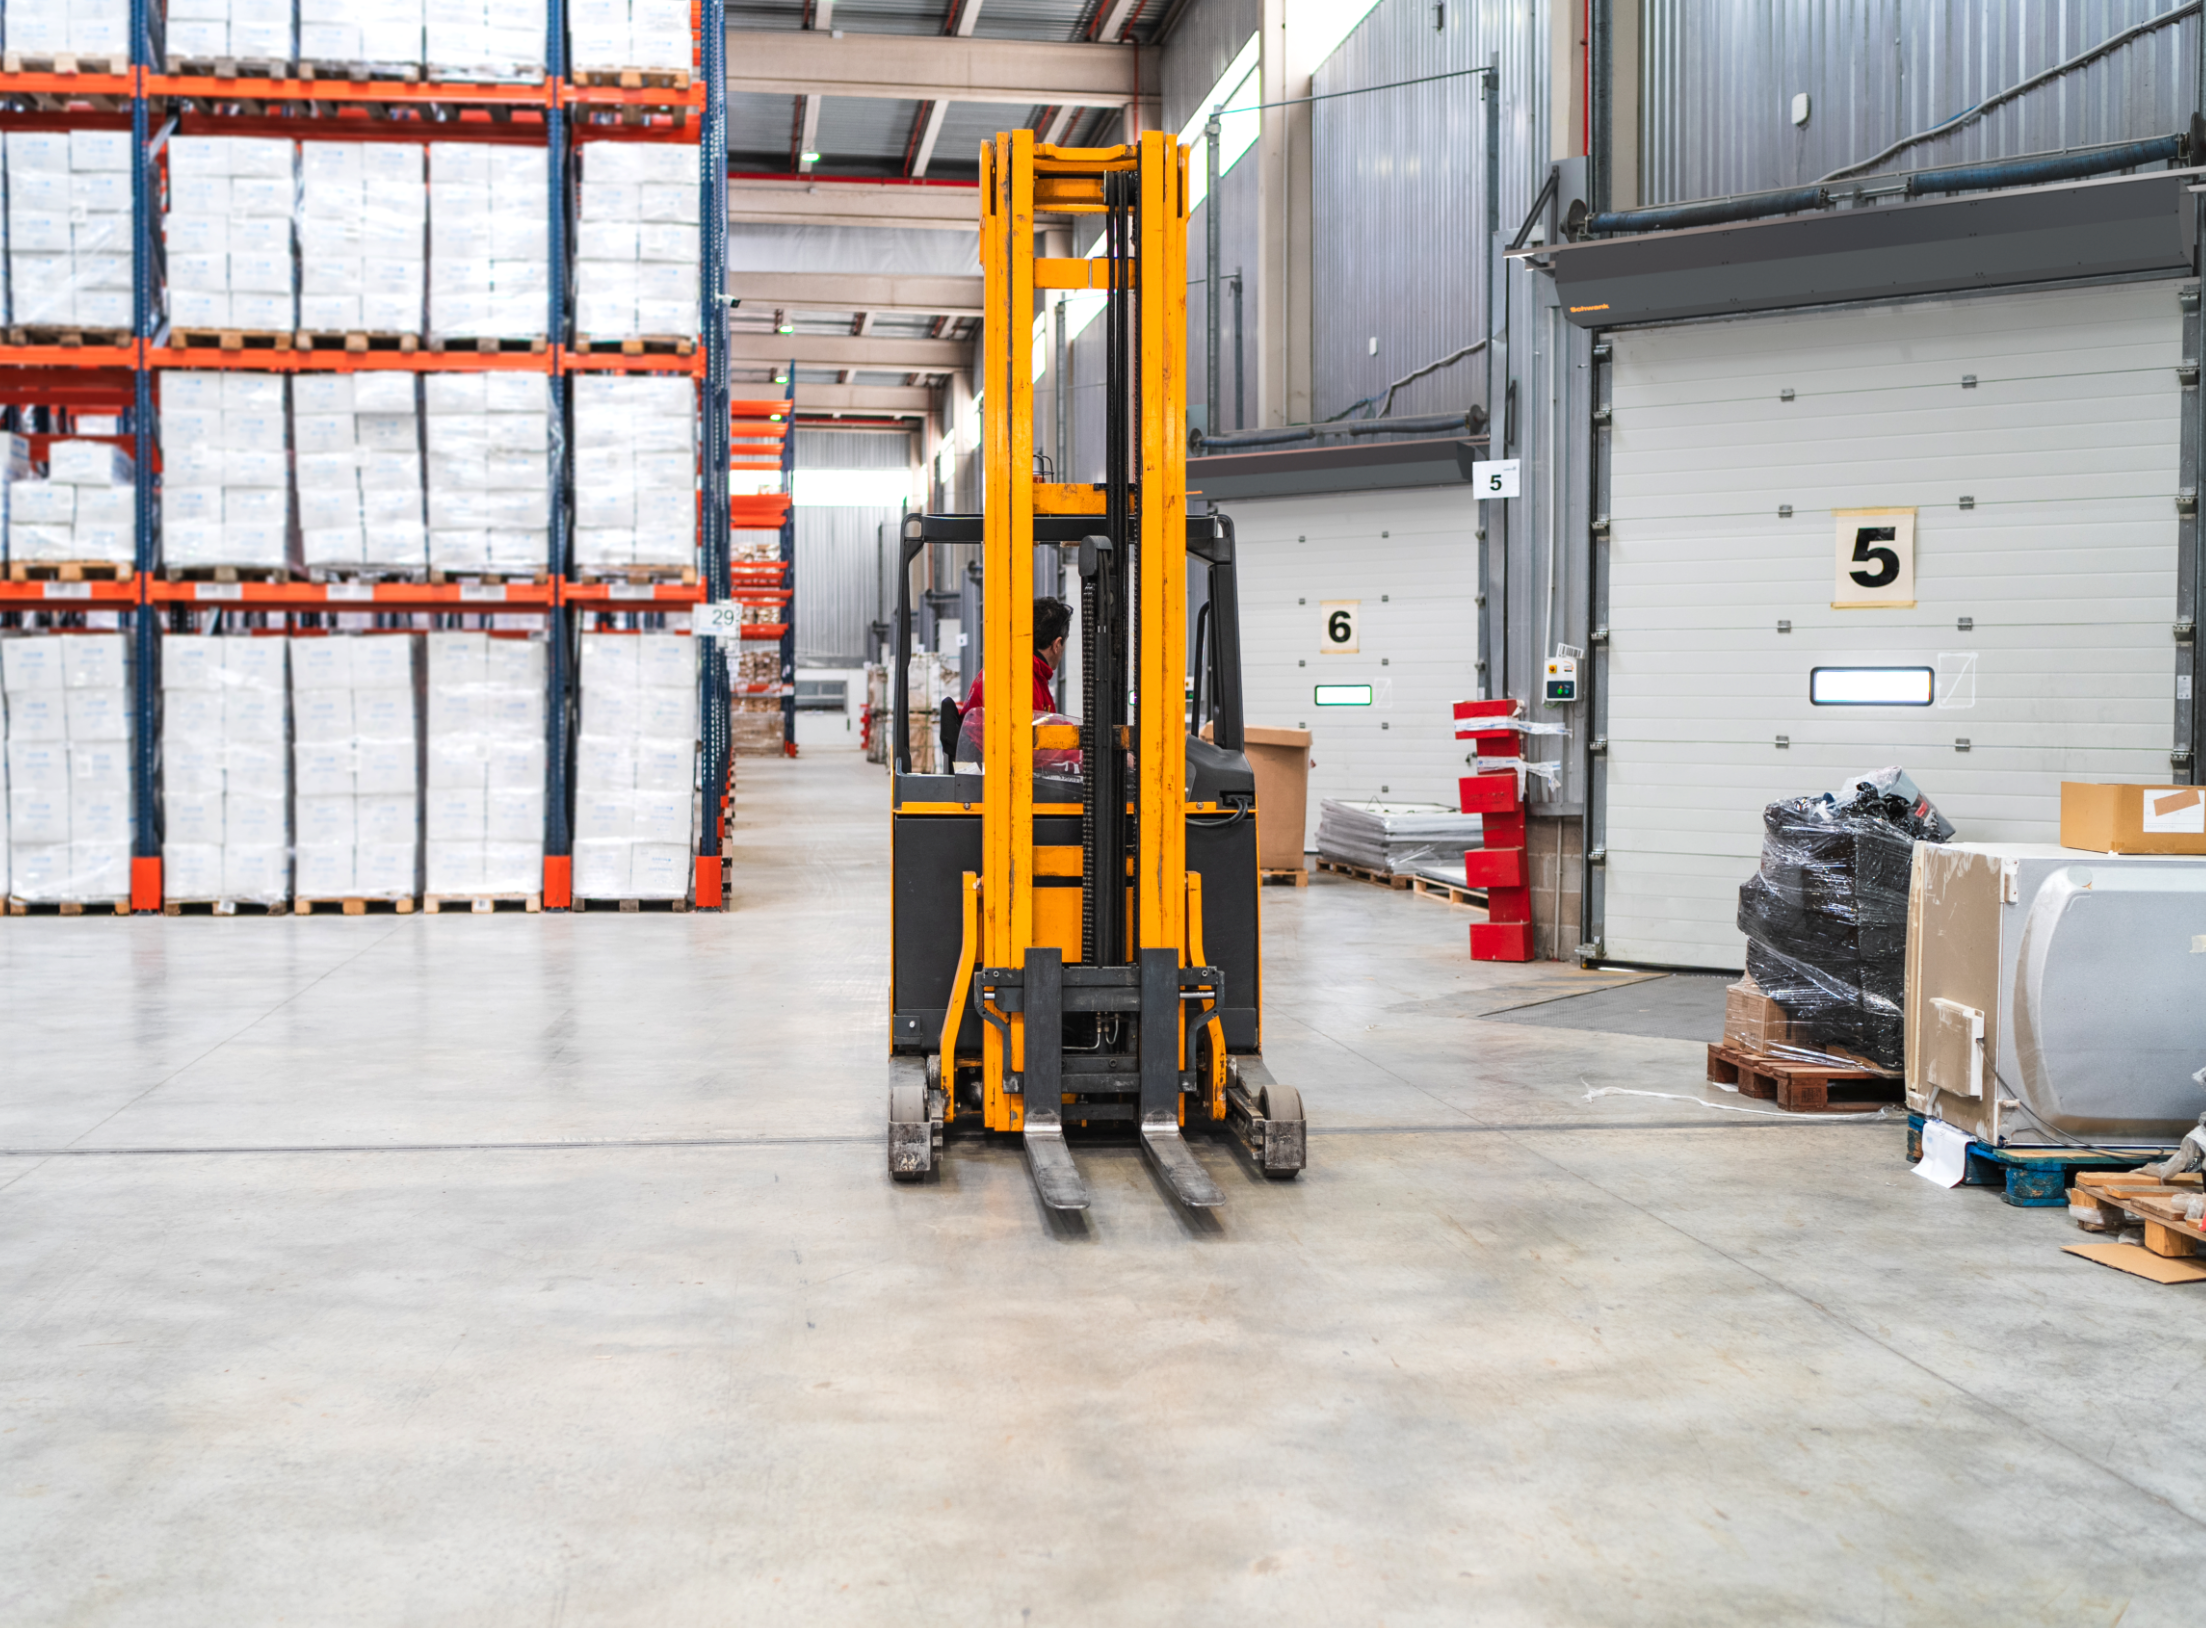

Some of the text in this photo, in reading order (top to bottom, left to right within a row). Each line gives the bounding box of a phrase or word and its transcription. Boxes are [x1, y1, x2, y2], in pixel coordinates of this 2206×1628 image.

[1570, 303, 1610, 313] Schwank
[1490, 474, 1502, 491] 5
[1849, 526, 1900, 588] 5
[712, 609, 734, 626] 29
[1328, 610, 1351, 643] 6
